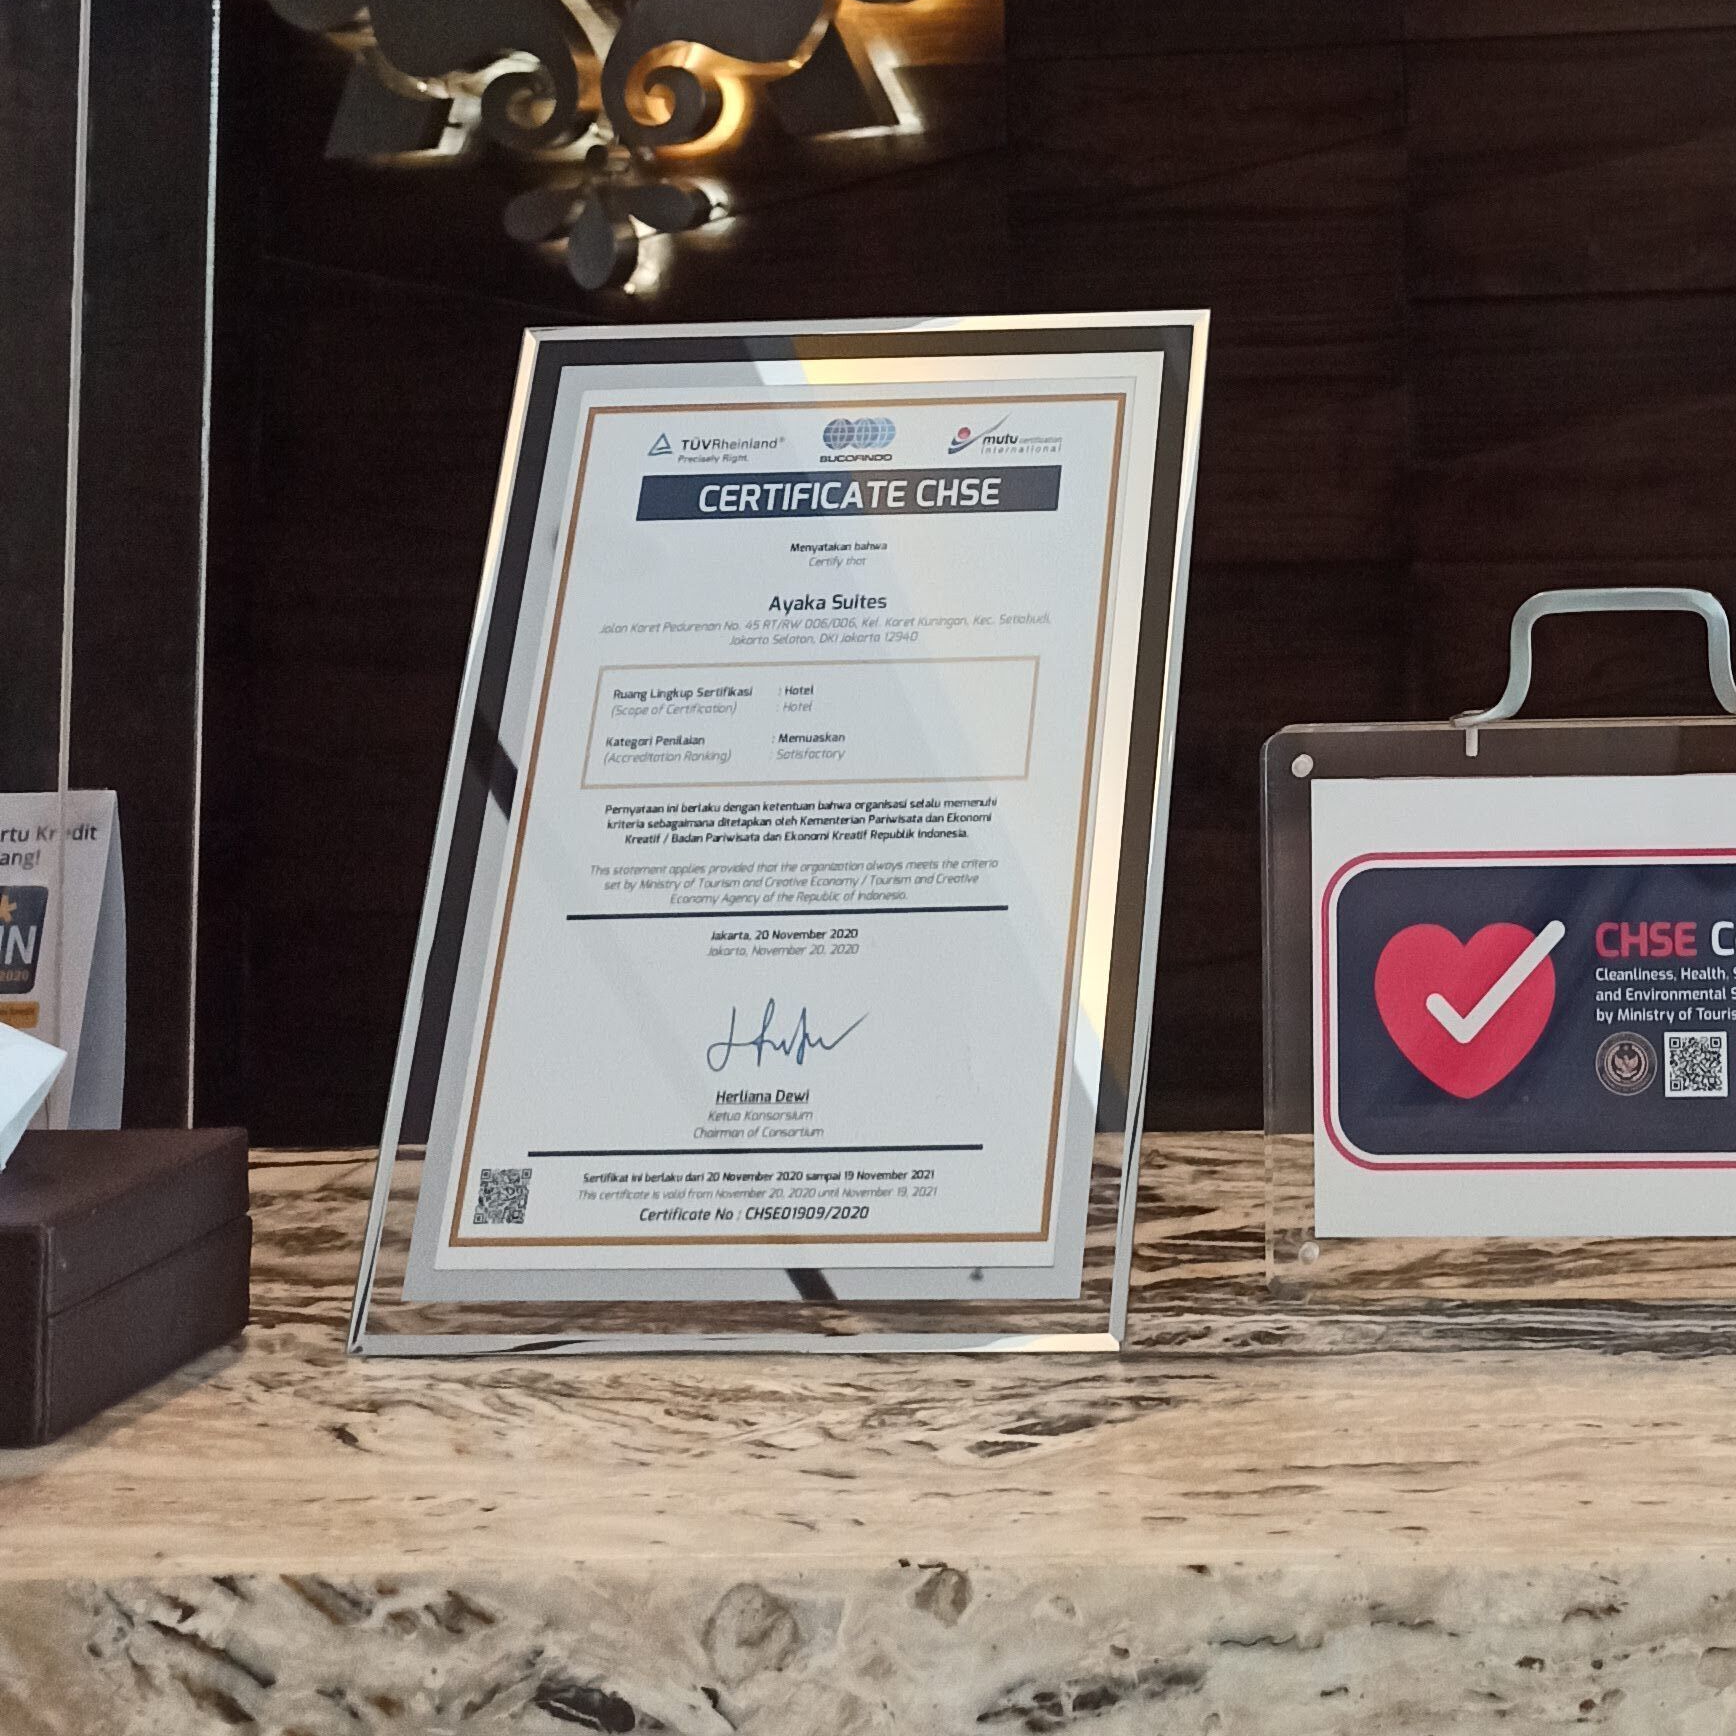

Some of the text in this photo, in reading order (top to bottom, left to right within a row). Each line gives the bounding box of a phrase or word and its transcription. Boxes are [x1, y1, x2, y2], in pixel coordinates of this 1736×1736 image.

[819, 453, 892, 462] SUCOFINDO
[698, 477, 1001, 512] CERTIFICATE CHSE
[790, 542, 887, 553] Menyatakan bahwa
[768, 593, 886, 614] Ayaka Suites
[613, 689, 647, 701] Ruang
[650, 688, 693, 701] Lingkup
[697, 686, 752, 697] Sertifikasi
[784, 685, 813, 695] Hotel
[782, 701, 812, 711] Hotel
[605, 738, 652, 749] Kategori
[655, 735, 704, 745] Penilaian
[778, 733, 845, 742] Memuaskan
[605, 797, 996, 816] Pernyataan ini berlaku dengan ketentuan bahwa organisasi selalu memenuhi
[607, 812, 991, 831] kriteria sebagaimana ditetapkan oleh Kementerian Pariwisata dan Ekonomi
[36, 824, 97, 842] Krdit
[624, 834, 660, 843] Kreatif
[671, 833, 703, 843] Badan
[705, 832, 760, 842] Pariwisata
[762, 832, 781, 841] dan
[784, 831, 829, 841] Ekonomi
[832, 829, 867, 840] Kreatif
[870, 828, 914, 841] Republik
[755, 929, 769, 940] 20
[771, 929, 825, 939] November
[830, 928, 858, 938] 2020
[1595, 921, 1696, 957] CHSE
[1595, 967, 1676, 981] Cleanliness,
[1680, 966, 1728, 979] Health,
[1595, 987, 1621, 1001] and
[1625, 987, 1726, 1000] Environmental
[1596, 1008, 1613, 1024] by
[1617, 1007, 1674, 1023] Ministry
[1678, 1006, 1692, 1020] of
[716, 1089, 809, 1102] Herliana Dewi
[583, 1169, 934, 1182] Sertifikat ini berlaku dari 20 November 2020 sampai 19 November 2021
[639, 1206, 711, 1221] Certificate
[714, 1207, 733, 1220] No
[745, 1205, 869, 1220] CHSE01909/2020
